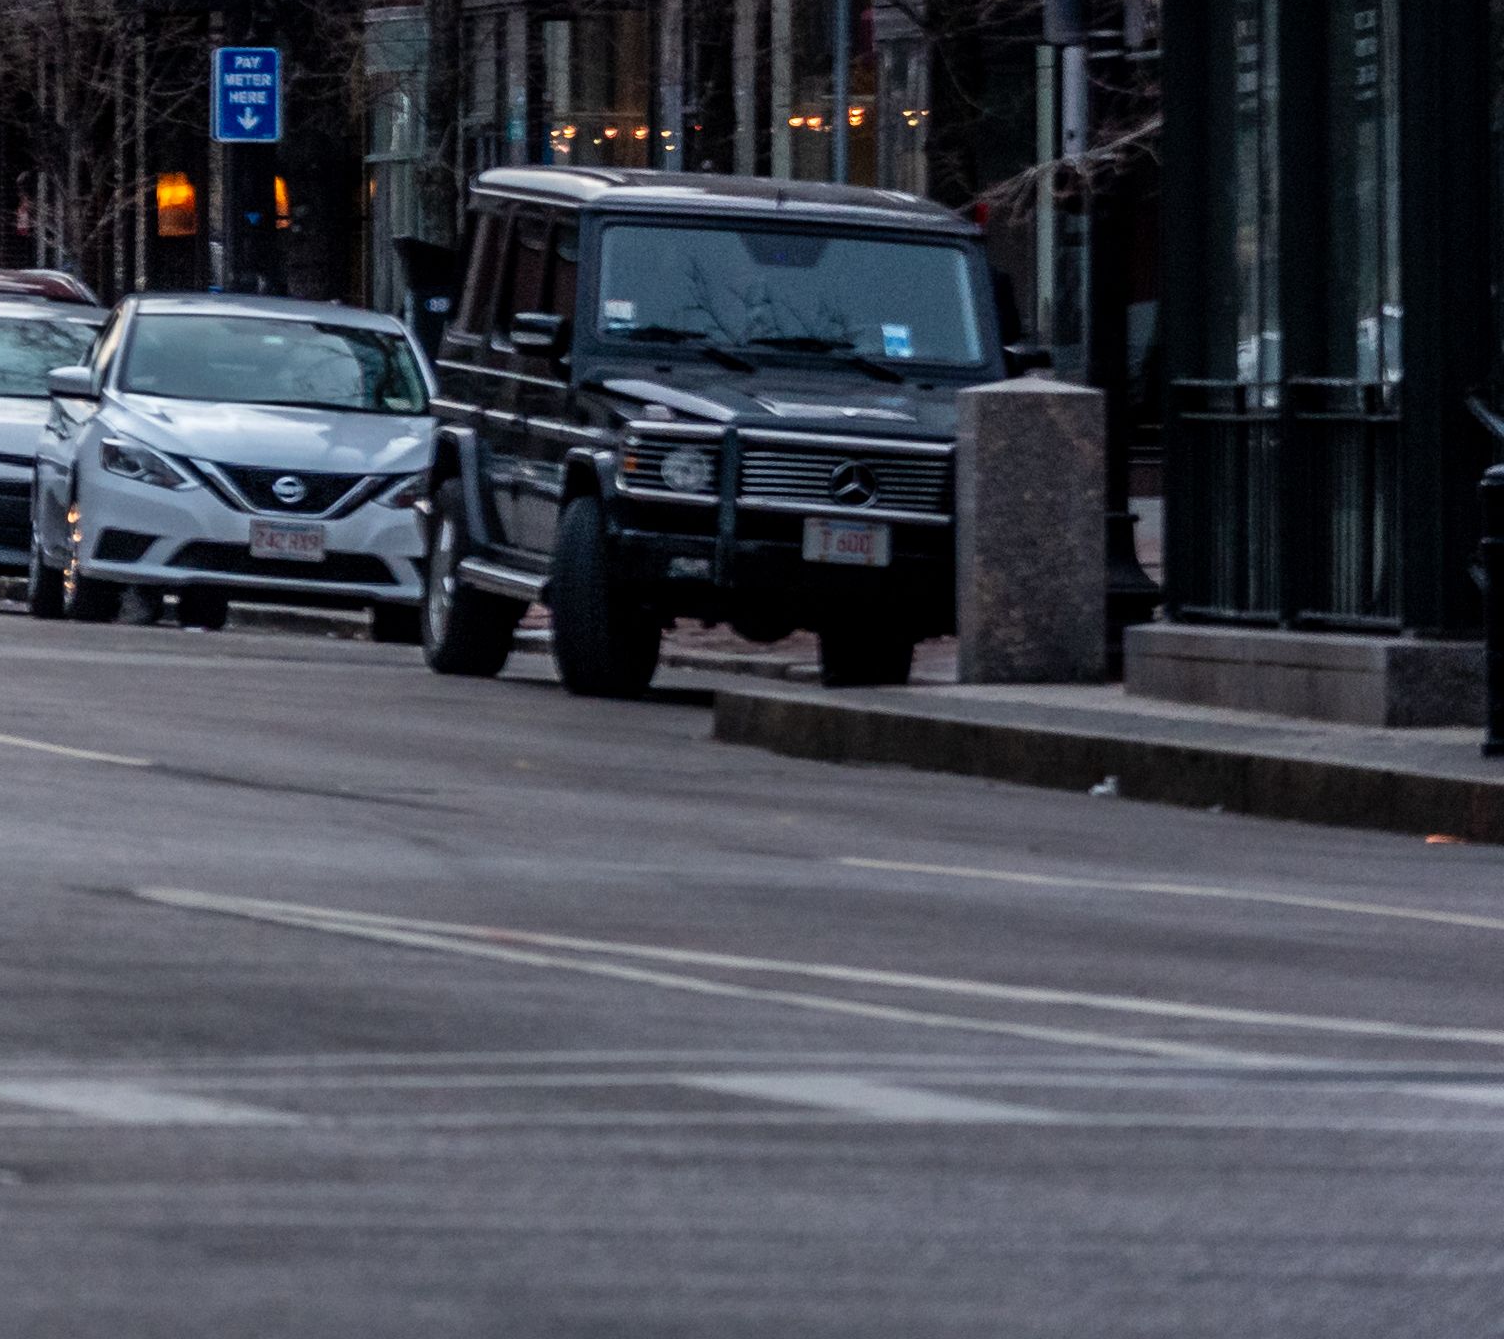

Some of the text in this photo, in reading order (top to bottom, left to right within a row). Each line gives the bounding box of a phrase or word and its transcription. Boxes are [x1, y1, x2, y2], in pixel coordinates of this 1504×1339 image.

[234, 56, 262, 69] PAY
[223, 73, 272, 87] METER
[229, 91, 268, 104] HERE
